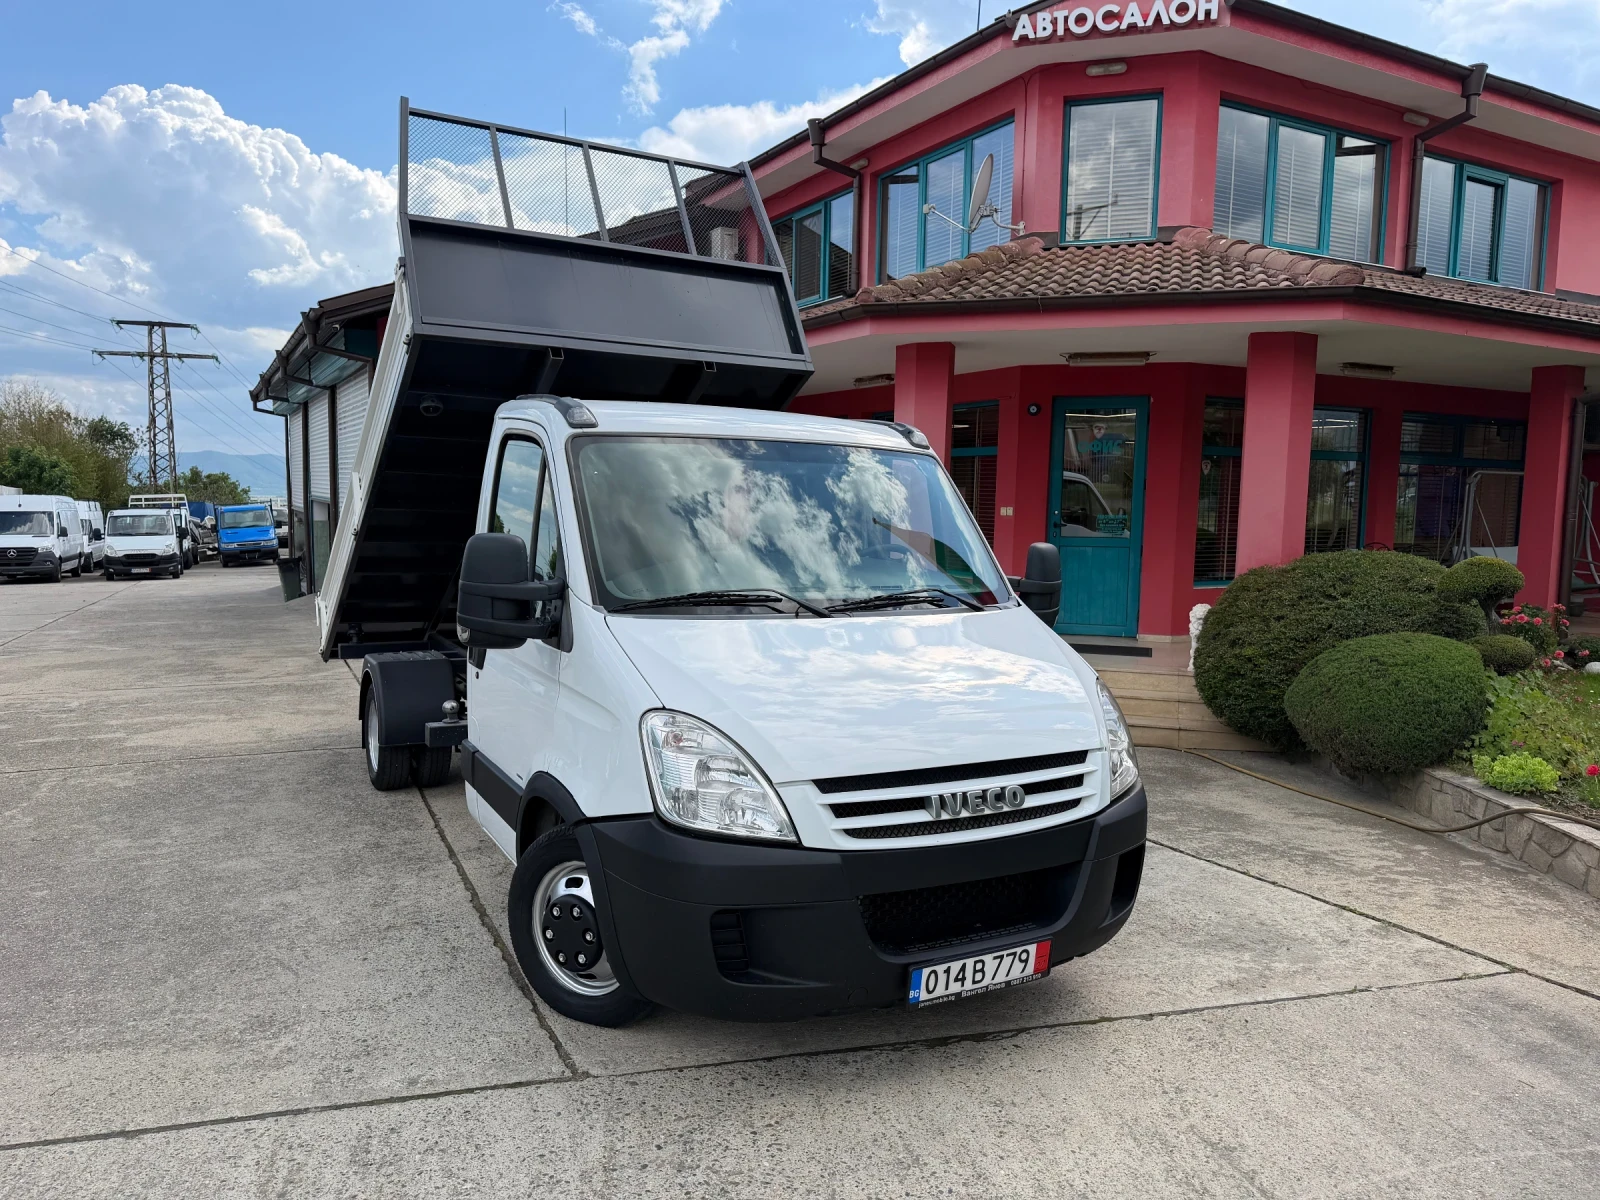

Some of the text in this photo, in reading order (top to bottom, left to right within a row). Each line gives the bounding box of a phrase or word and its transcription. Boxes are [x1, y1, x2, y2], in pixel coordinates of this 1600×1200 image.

[1012, 0, 1219, 41] АВТОСАЛОН
[1078, 439, 1123, 454] ОФИС
[926, 785, 1026, 819] IVECO
[909, 989, 920, 998] BG
